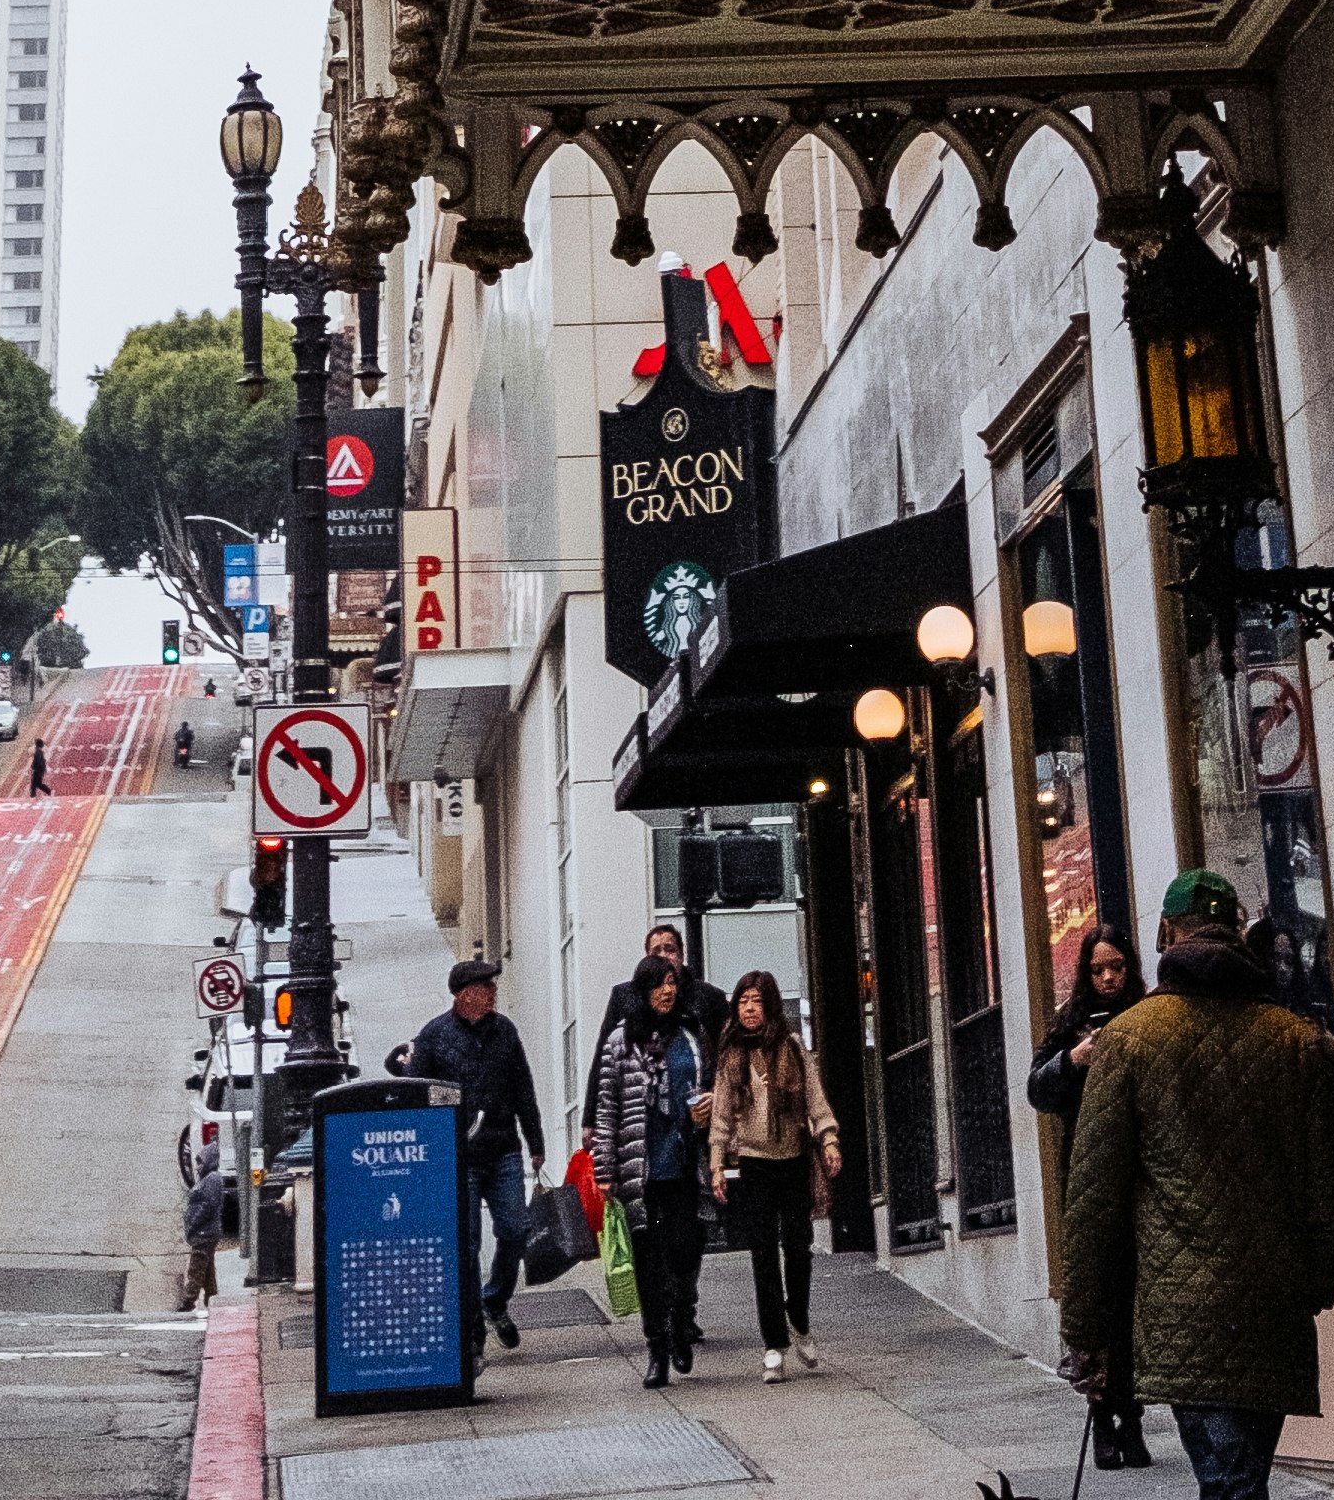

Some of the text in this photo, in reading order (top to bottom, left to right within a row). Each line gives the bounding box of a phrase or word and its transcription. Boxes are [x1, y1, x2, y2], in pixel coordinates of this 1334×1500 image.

[612, 446, 744, 499] BEACON
[626, 485, 733, 525] GRAND
[327, 524, 396, 536] VERSITY
[363, 1129, 417, 1145] UNION
[350, 1143, 430, 1169] SQUARE
